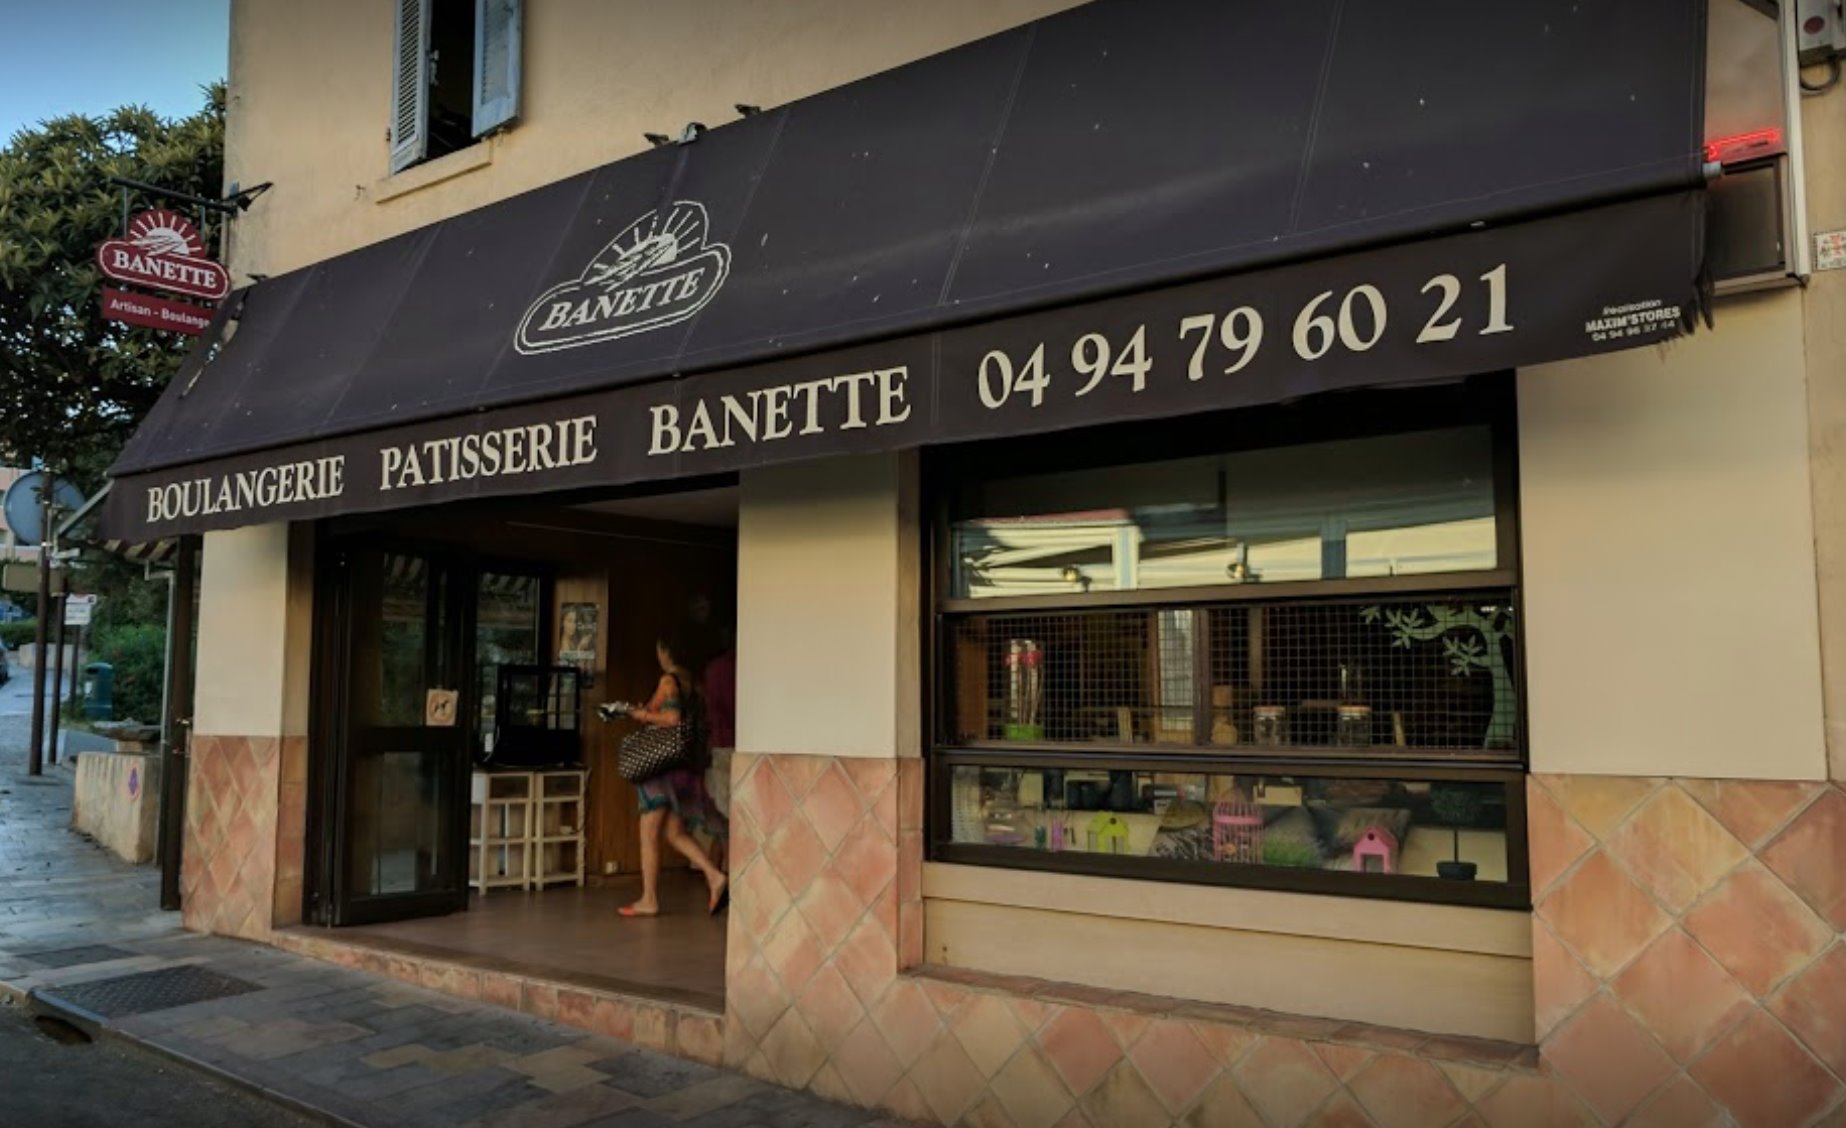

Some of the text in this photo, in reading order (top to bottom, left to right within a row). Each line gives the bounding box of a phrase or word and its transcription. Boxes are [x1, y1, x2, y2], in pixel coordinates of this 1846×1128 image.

[112, 250, 217, 289] BANETTE
[110, 299, 152, 317] Artisan
[538, 267, 706, 332] BANETTE
[1585, 306, 1681, 333] MAXIM'STORES
[1592, 332, 1607, 342] 04
[146, 263, 1514, 524] BOULANGERIE PATISSERIE BANETTE 04 94 79 60 21
